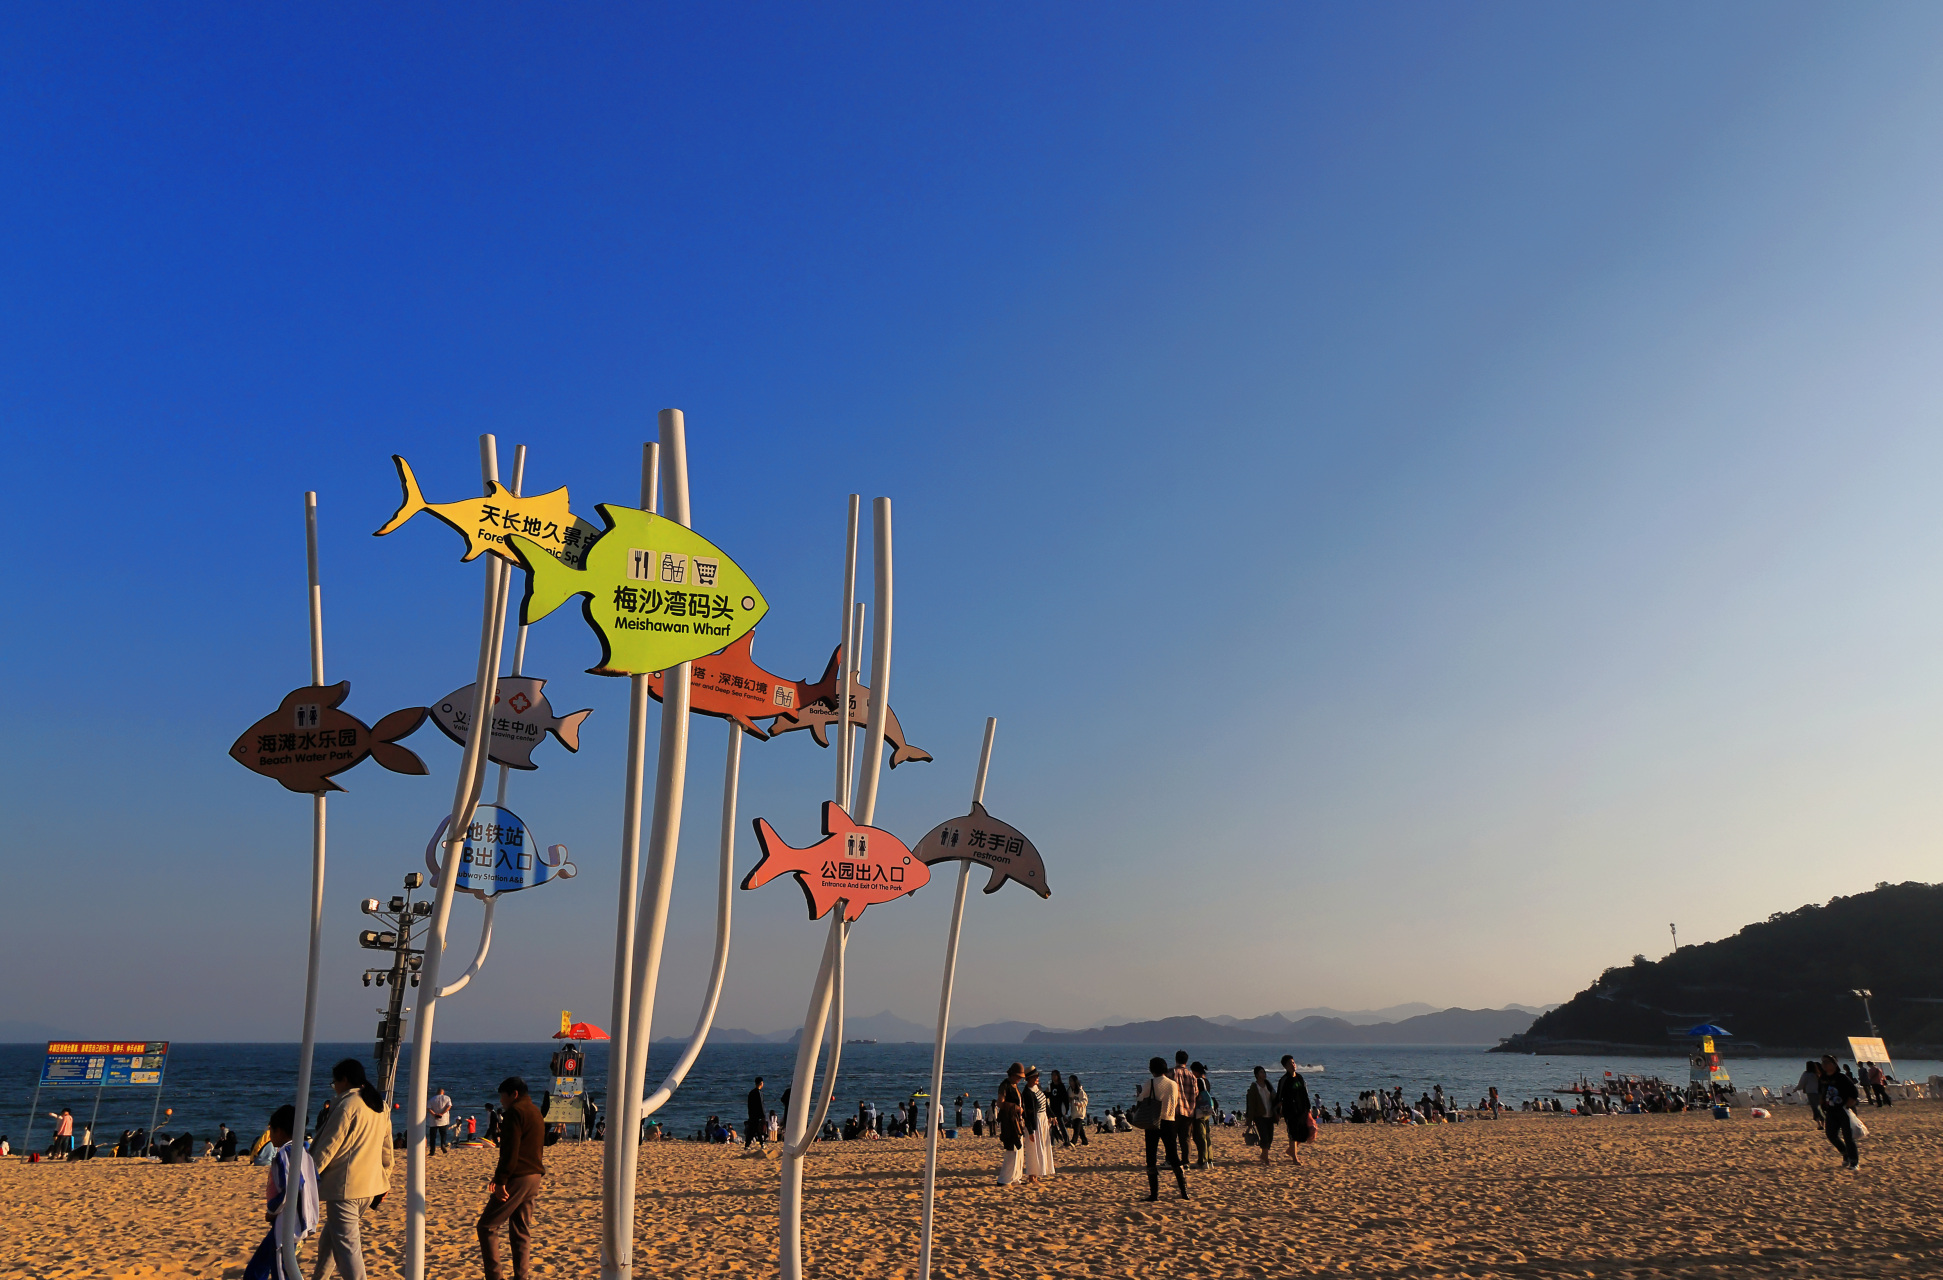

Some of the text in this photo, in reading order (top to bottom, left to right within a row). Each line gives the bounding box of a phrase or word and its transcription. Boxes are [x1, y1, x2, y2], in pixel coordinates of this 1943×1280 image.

[478, 528, 504, 543] Fore
[613, 585, 734, 621] 梅沙湾码头
[614, 616, 731, 636] Meishawan Wharf
[691, 666, 768, 694] 塔·深海幻境
[702, 683, 714, 691] and
[715, 686, 731, 695] Deep
[732, 689, 742, 697] Sea
[743, 692, 766, 703] Fantasy
[809, 708, 839, 716] Barbecue
[257, 728, 357, 754] 海滩水乐园
[260, 750, 354, 766] Beach Water Park
[466, 821, 525, 847] 地铁站
[967, 828, 1025, 857] 洗手间
[461, 846, 533, 871] B出入口
[973, 850, 1011, 865] restroom
[457, 870, 524, 884] ubway Station A&B
[821, 861, 904, 883] 公园出入口
